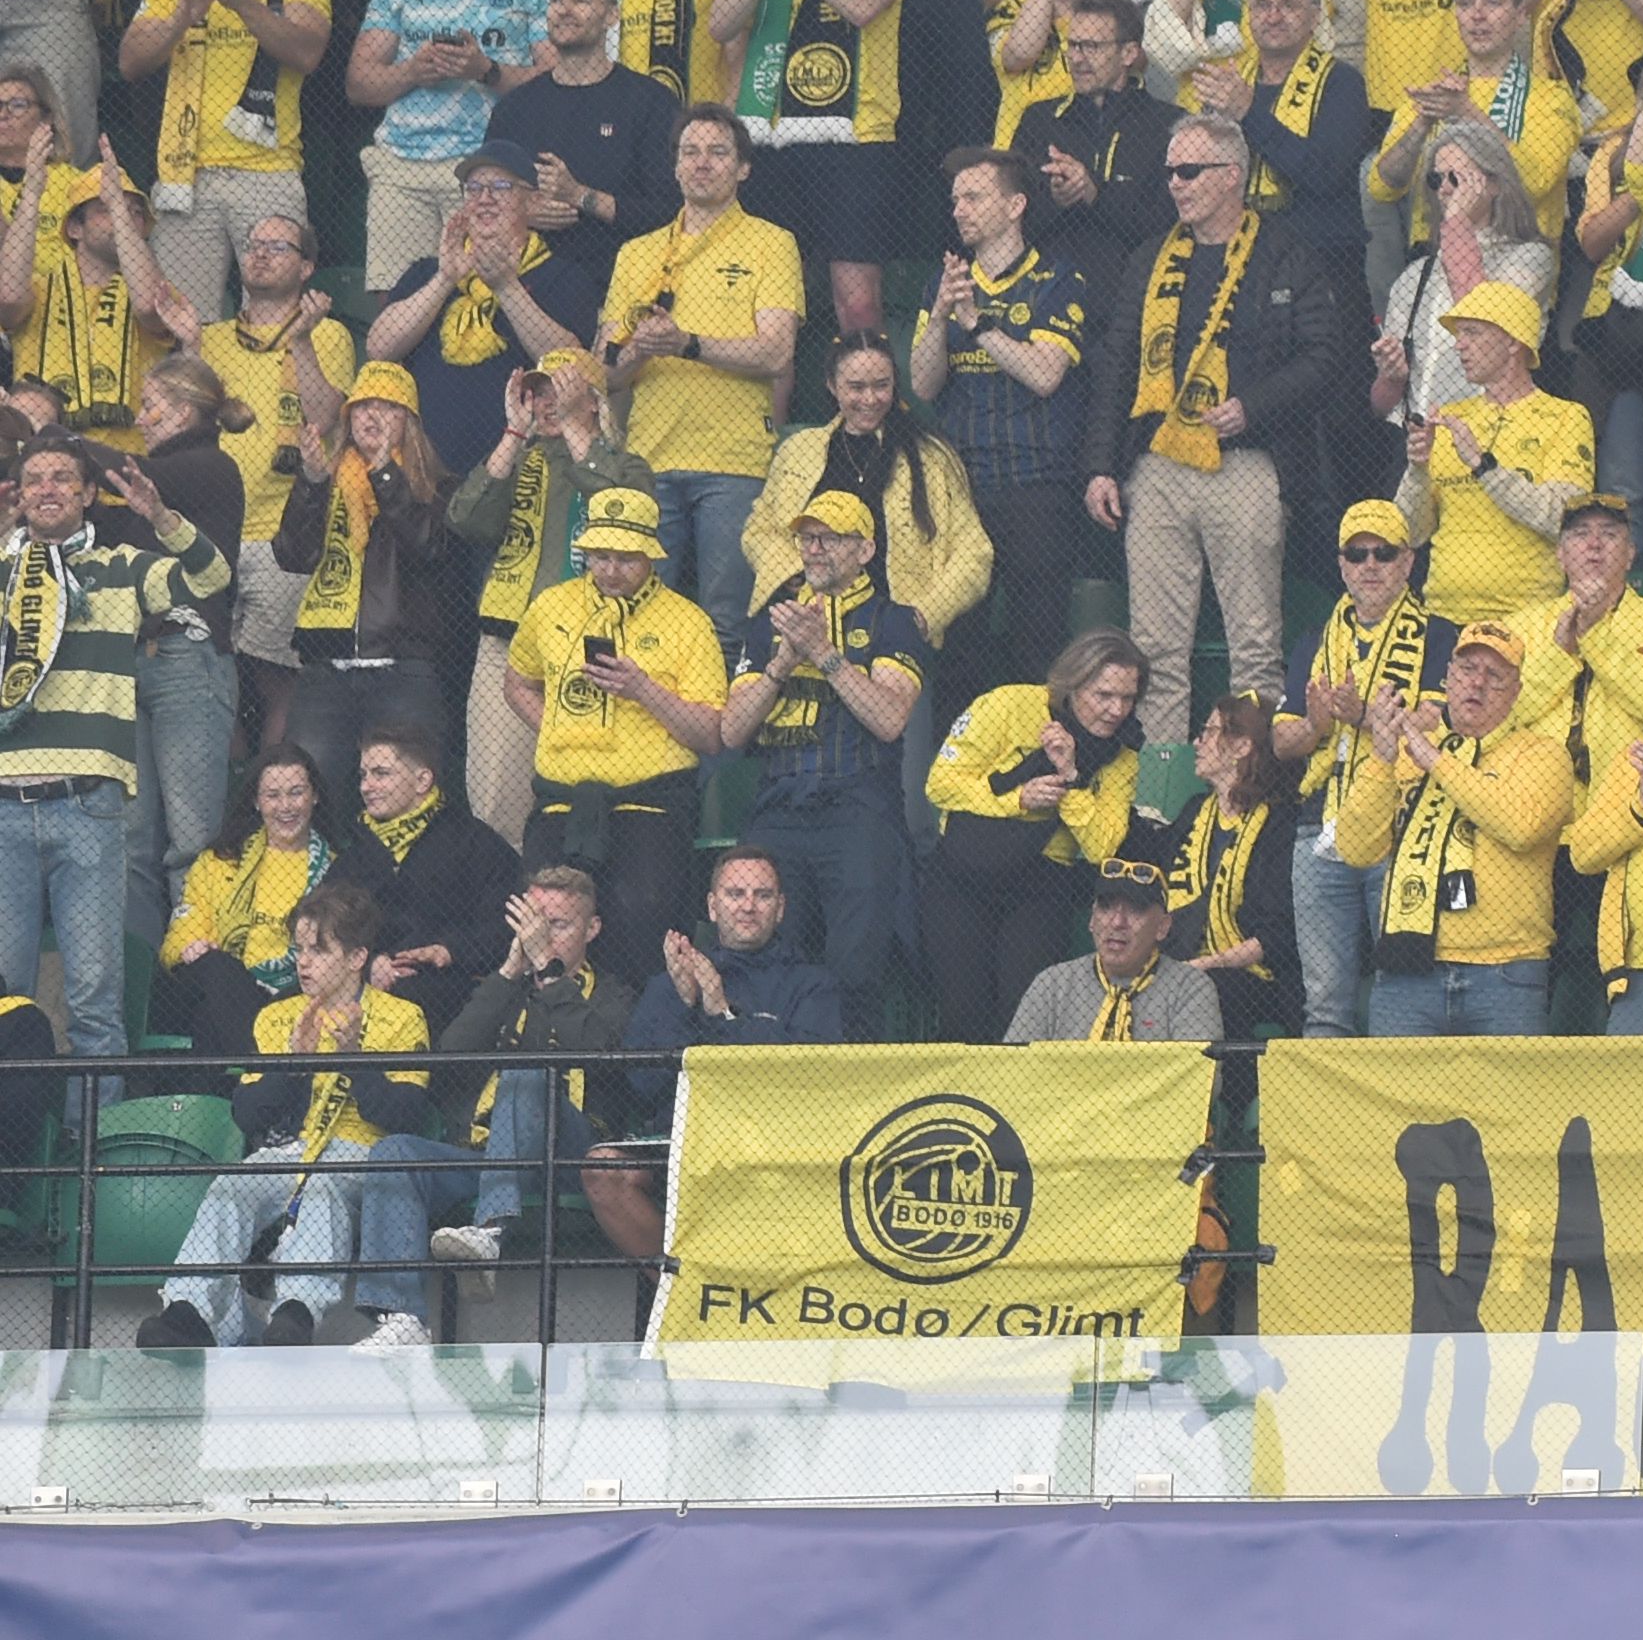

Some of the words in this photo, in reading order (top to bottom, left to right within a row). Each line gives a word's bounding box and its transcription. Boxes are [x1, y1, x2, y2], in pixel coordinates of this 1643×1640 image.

[896, 1204, 967, 1229] BODØ
[974, 1210, 1016, 1232] 1916
[699, 1283, 777, 1326] FK
[799, 1285, 1145, 1339] Bodø/Glimt
